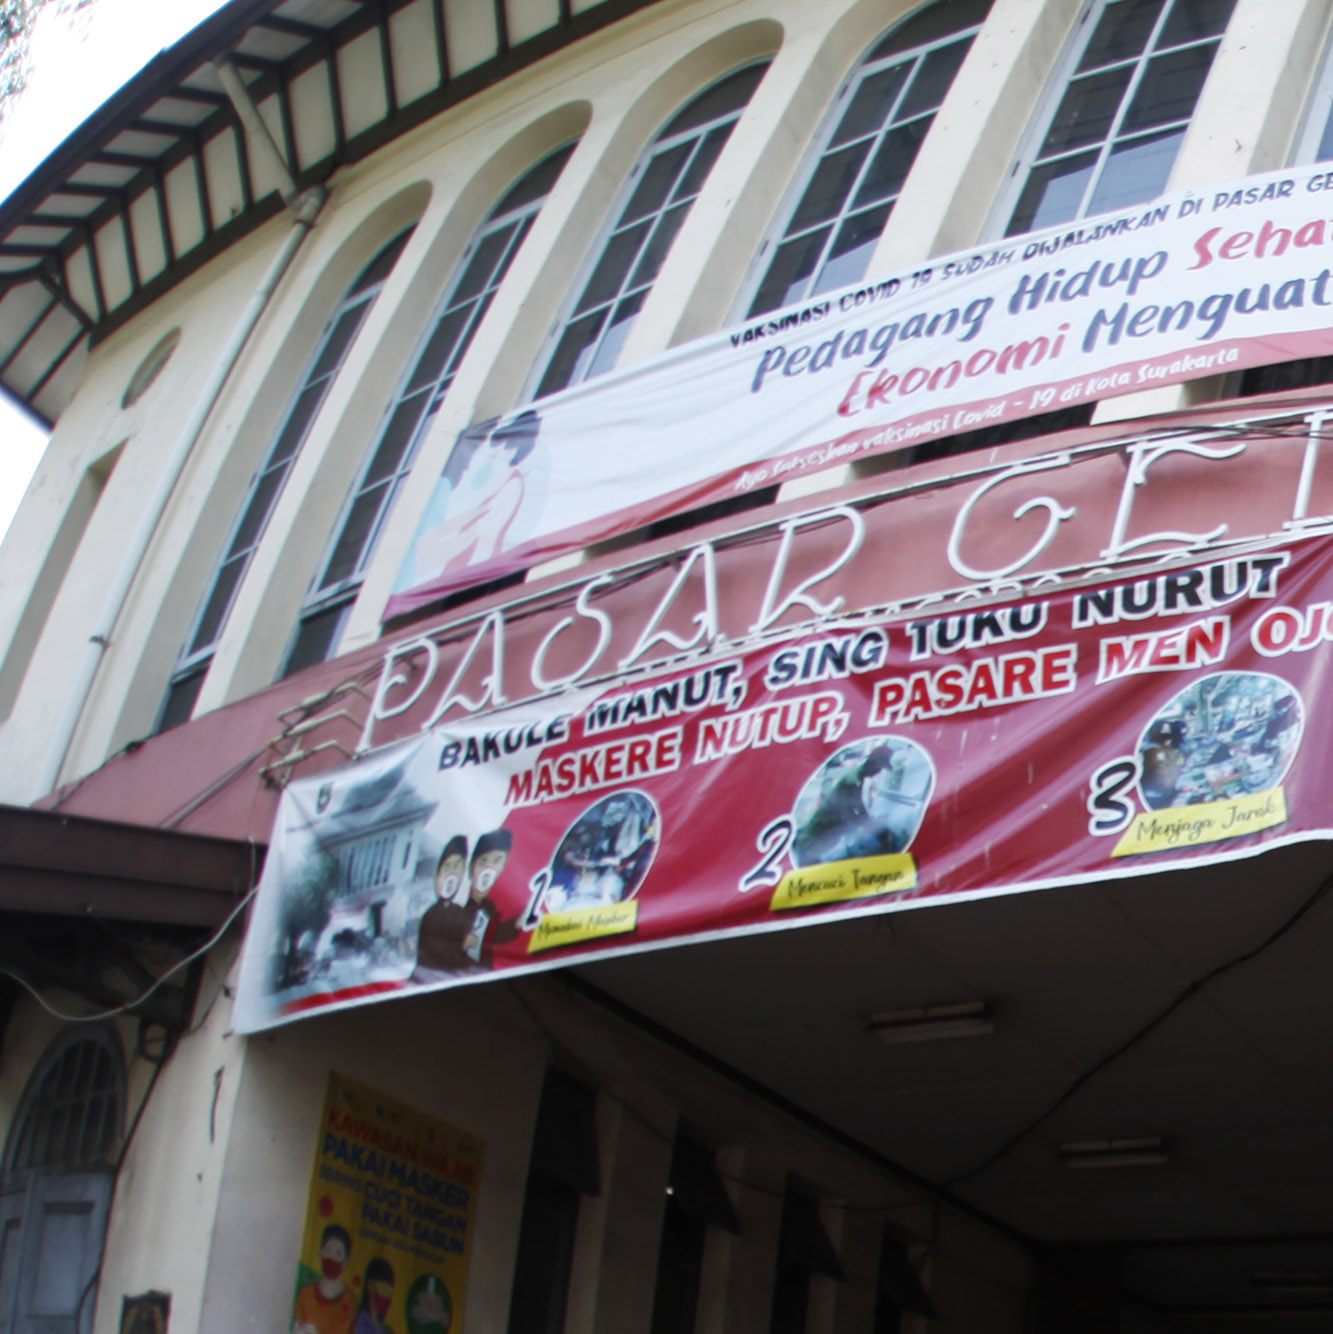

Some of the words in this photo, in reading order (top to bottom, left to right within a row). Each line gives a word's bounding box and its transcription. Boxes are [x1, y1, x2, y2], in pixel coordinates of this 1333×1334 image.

[729, 301, 831, 350] VAKSINASI
[838, 277, 901, 315] COVID
[909, 267, 934, 291] 19
[940, 249, 1016, 281] SUDAH
[1022, 204, 1171, 261] DIJALANKAN
[1177, 195, 1204, 218] DI
[1212, 180, 1296, 214] PASAR
[751, 296, 995, 393] Pedagang
[1008, 250, 1169, 316] Hidup
[734, 466, 767, 491] Ayo
[862, 413, 950, 451] vaksinasi
[953, 399, 1003, 429] Covid
[1029, 386, 1057, 410] 19
[1060, 383, 1082, 403] di
[1085, 369, 1131, 395] Kota
[1137, 347, 1239, 382] Surakarta
[837, 323, 1071, 417] Ekonomi
[354, 507, 865, 760] PASAR
[440, 717, 570, 770] BAKULE
[584, 657, 750, 737] MANUT,
[766, 626, 890, 688] SING
[907, 600, 1049, 662] TUKU
[1072, 552, 1292, 629] NURUT
[504, 727, 685, 808] MASKERE
[693, 691, 851, 765] NUTUP,
[868, 643, 1078, 729] PASARE
[1095, 616, 1230, 685] MEN
[738, 814, 797, 893] 2
[1088, 755, 1143, 837] 3
[521, 867, 552, 932] 1
[322, 1132, 386, 1177] PAKAI
[388, 1160, 471, 1212] MASKER
